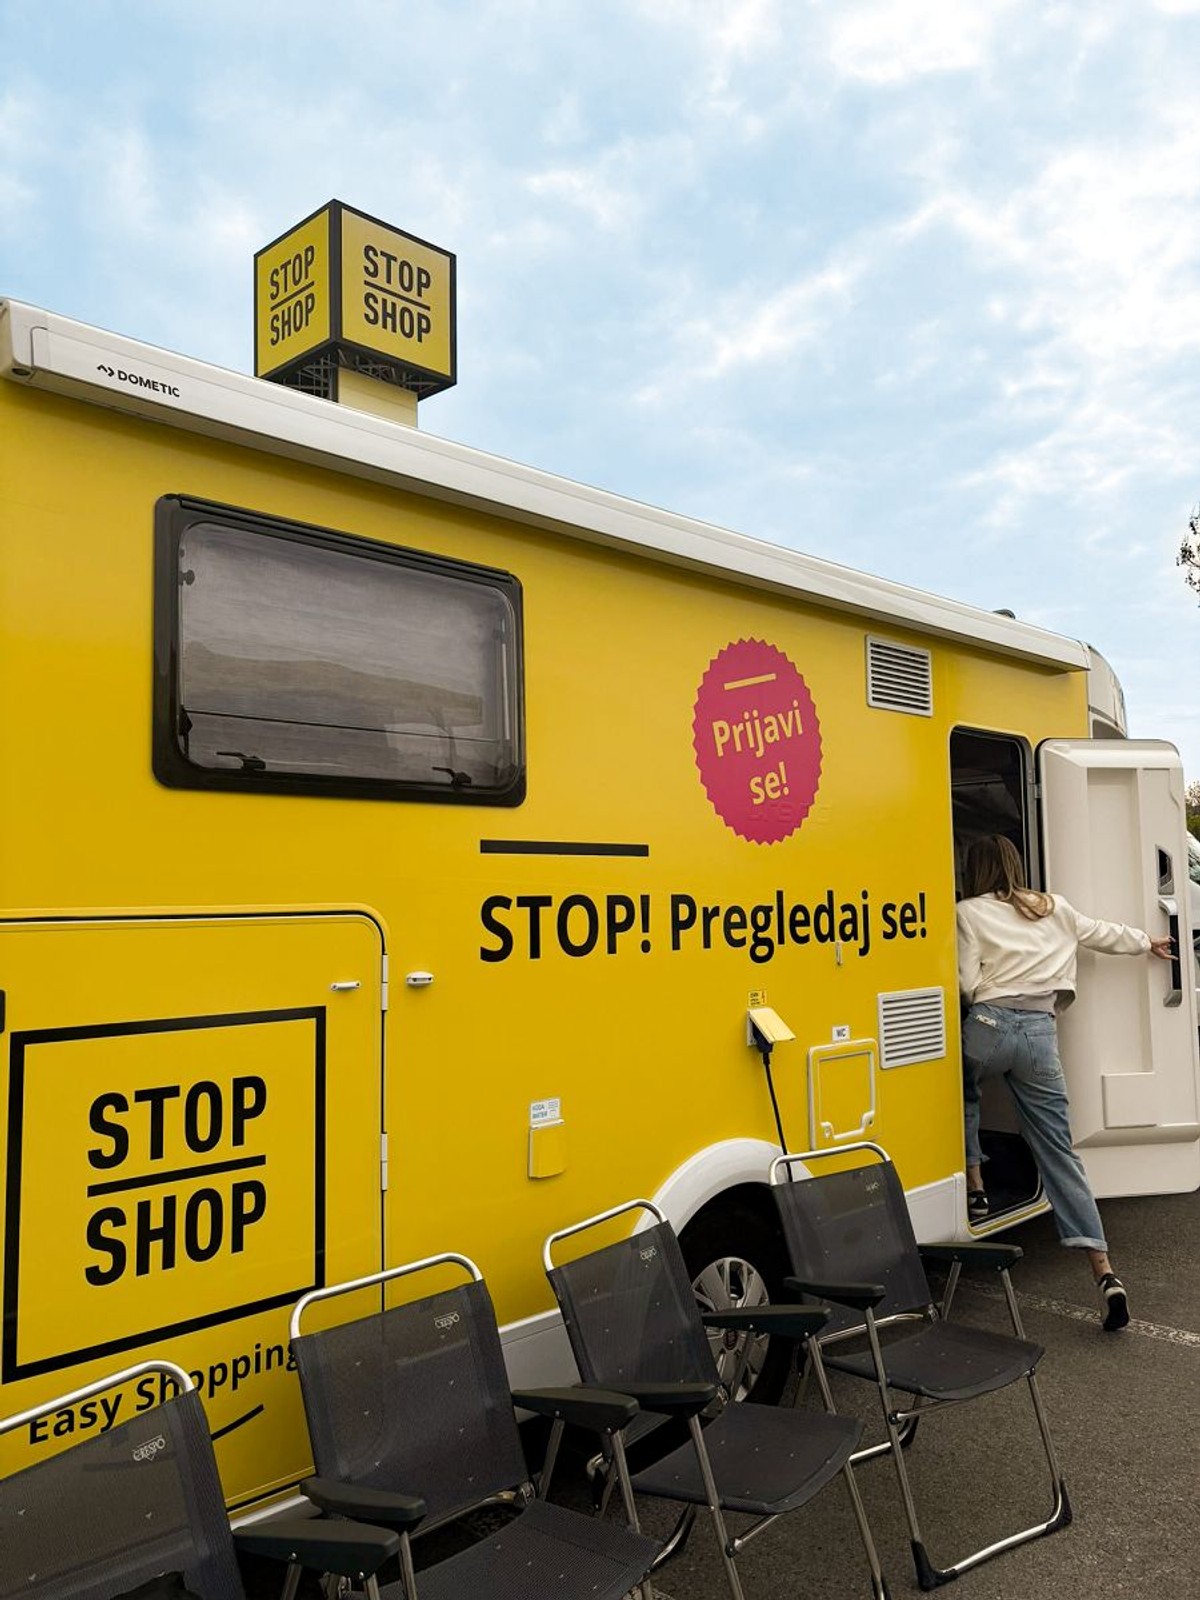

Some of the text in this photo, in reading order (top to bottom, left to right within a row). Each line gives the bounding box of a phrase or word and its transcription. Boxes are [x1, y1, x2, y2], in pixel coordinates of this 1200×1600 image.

[269, 245, 315, 300] STOP
[363, 244, 431, 297] STOP
[270, 292, 315, 346] SHOP
[363, 291, 431, 343] SHOP
[117, 369, 180, 398] DOMETIC
[712, 699, 803, 758] Prijavi
[749, 761, 790, 805] se!
[480, 889, 927, 964] STOP! Pregledaj se!
[87, 1075, 267, 1170] STOP
[85, 1179, 267, 1287] SHOP
[30, 1393, 122, 1445] Easy
